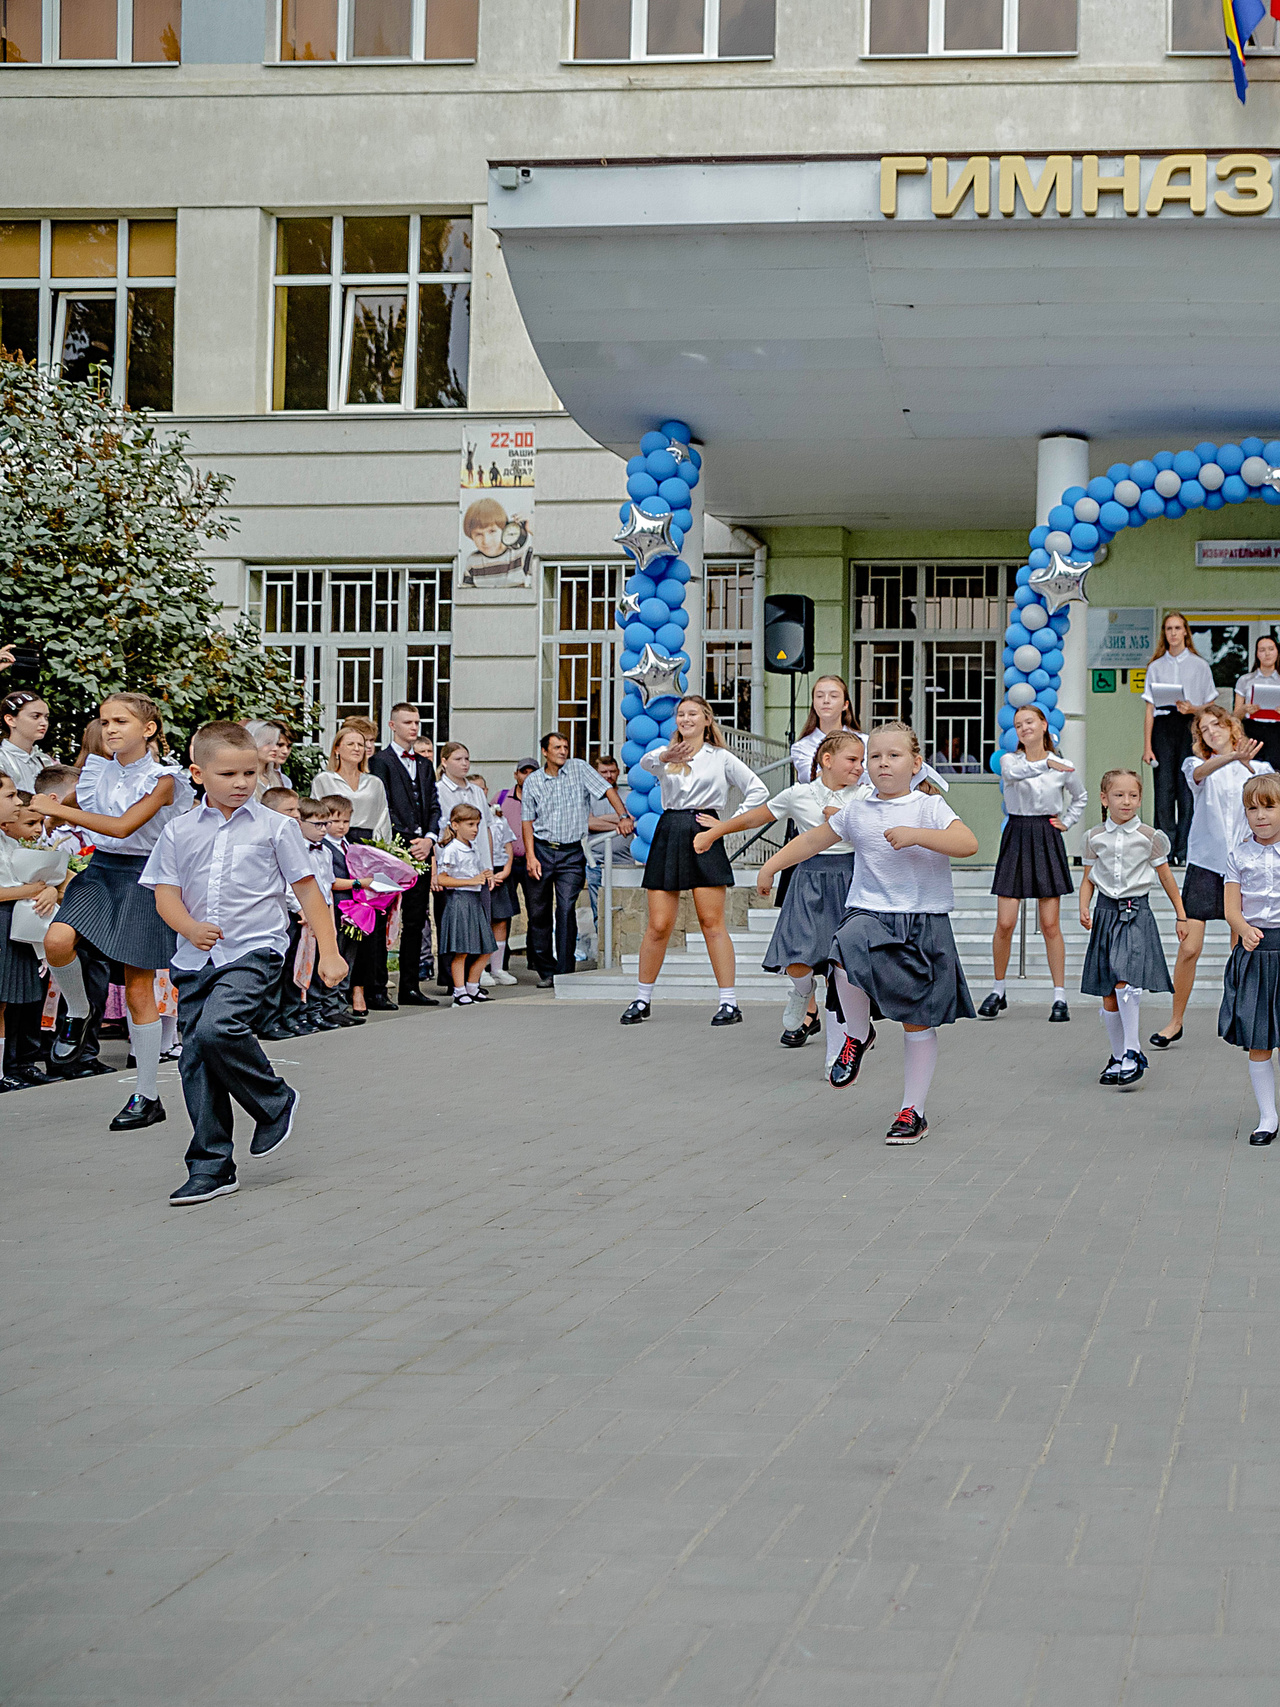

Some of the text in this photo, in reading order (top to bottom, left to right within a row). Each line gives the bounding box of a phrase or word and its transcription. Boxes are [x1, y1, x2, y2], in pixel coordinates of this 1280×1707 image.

[490, 431, 534, 448] 22-00
[508, 449, 534, 458] ВАШИ
[510, 459, 533, 467] ДЕТИ
[502, 467, 533, 476] ДОМА?
[1202, 546, 1272, 559] ИЗБИРАТЕЛЬНЫЙ
[1129, 635, 1150, 649] №35
